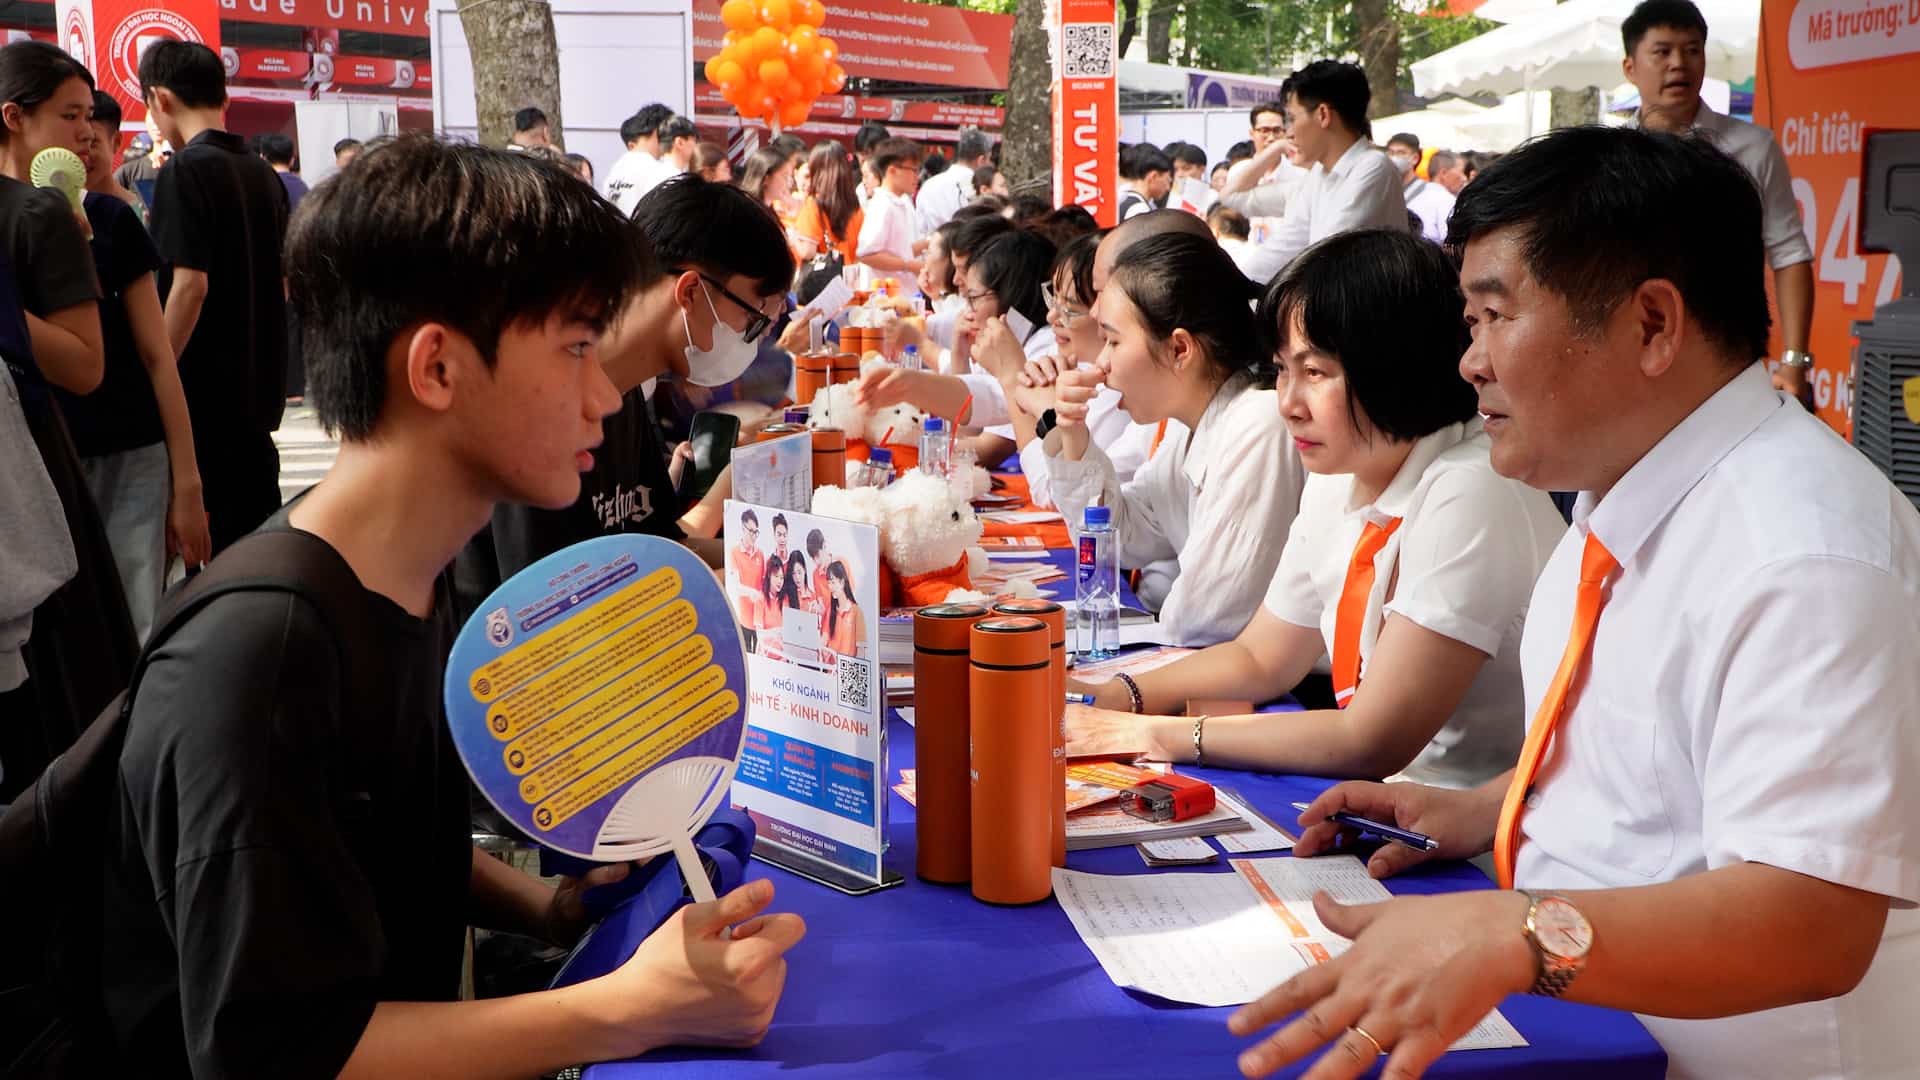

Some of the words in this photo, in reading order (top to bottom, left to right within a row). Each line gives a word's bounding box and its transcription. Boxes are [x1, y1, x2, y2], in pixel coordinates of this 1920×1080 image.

[1808, 10, 1832, 43] Mã
[1782, 112, 1819, 156] Chỉ
[1822, 111, 1865, 155] tiêu
[772, 677, 795, 694] KHỐI
[797, 684, 830, 702] NGÀNH
[766, 694, 780, 712] TẾ
[790, 703, 819, 724] KINH
[823, 712, 869, 737] DOANH
